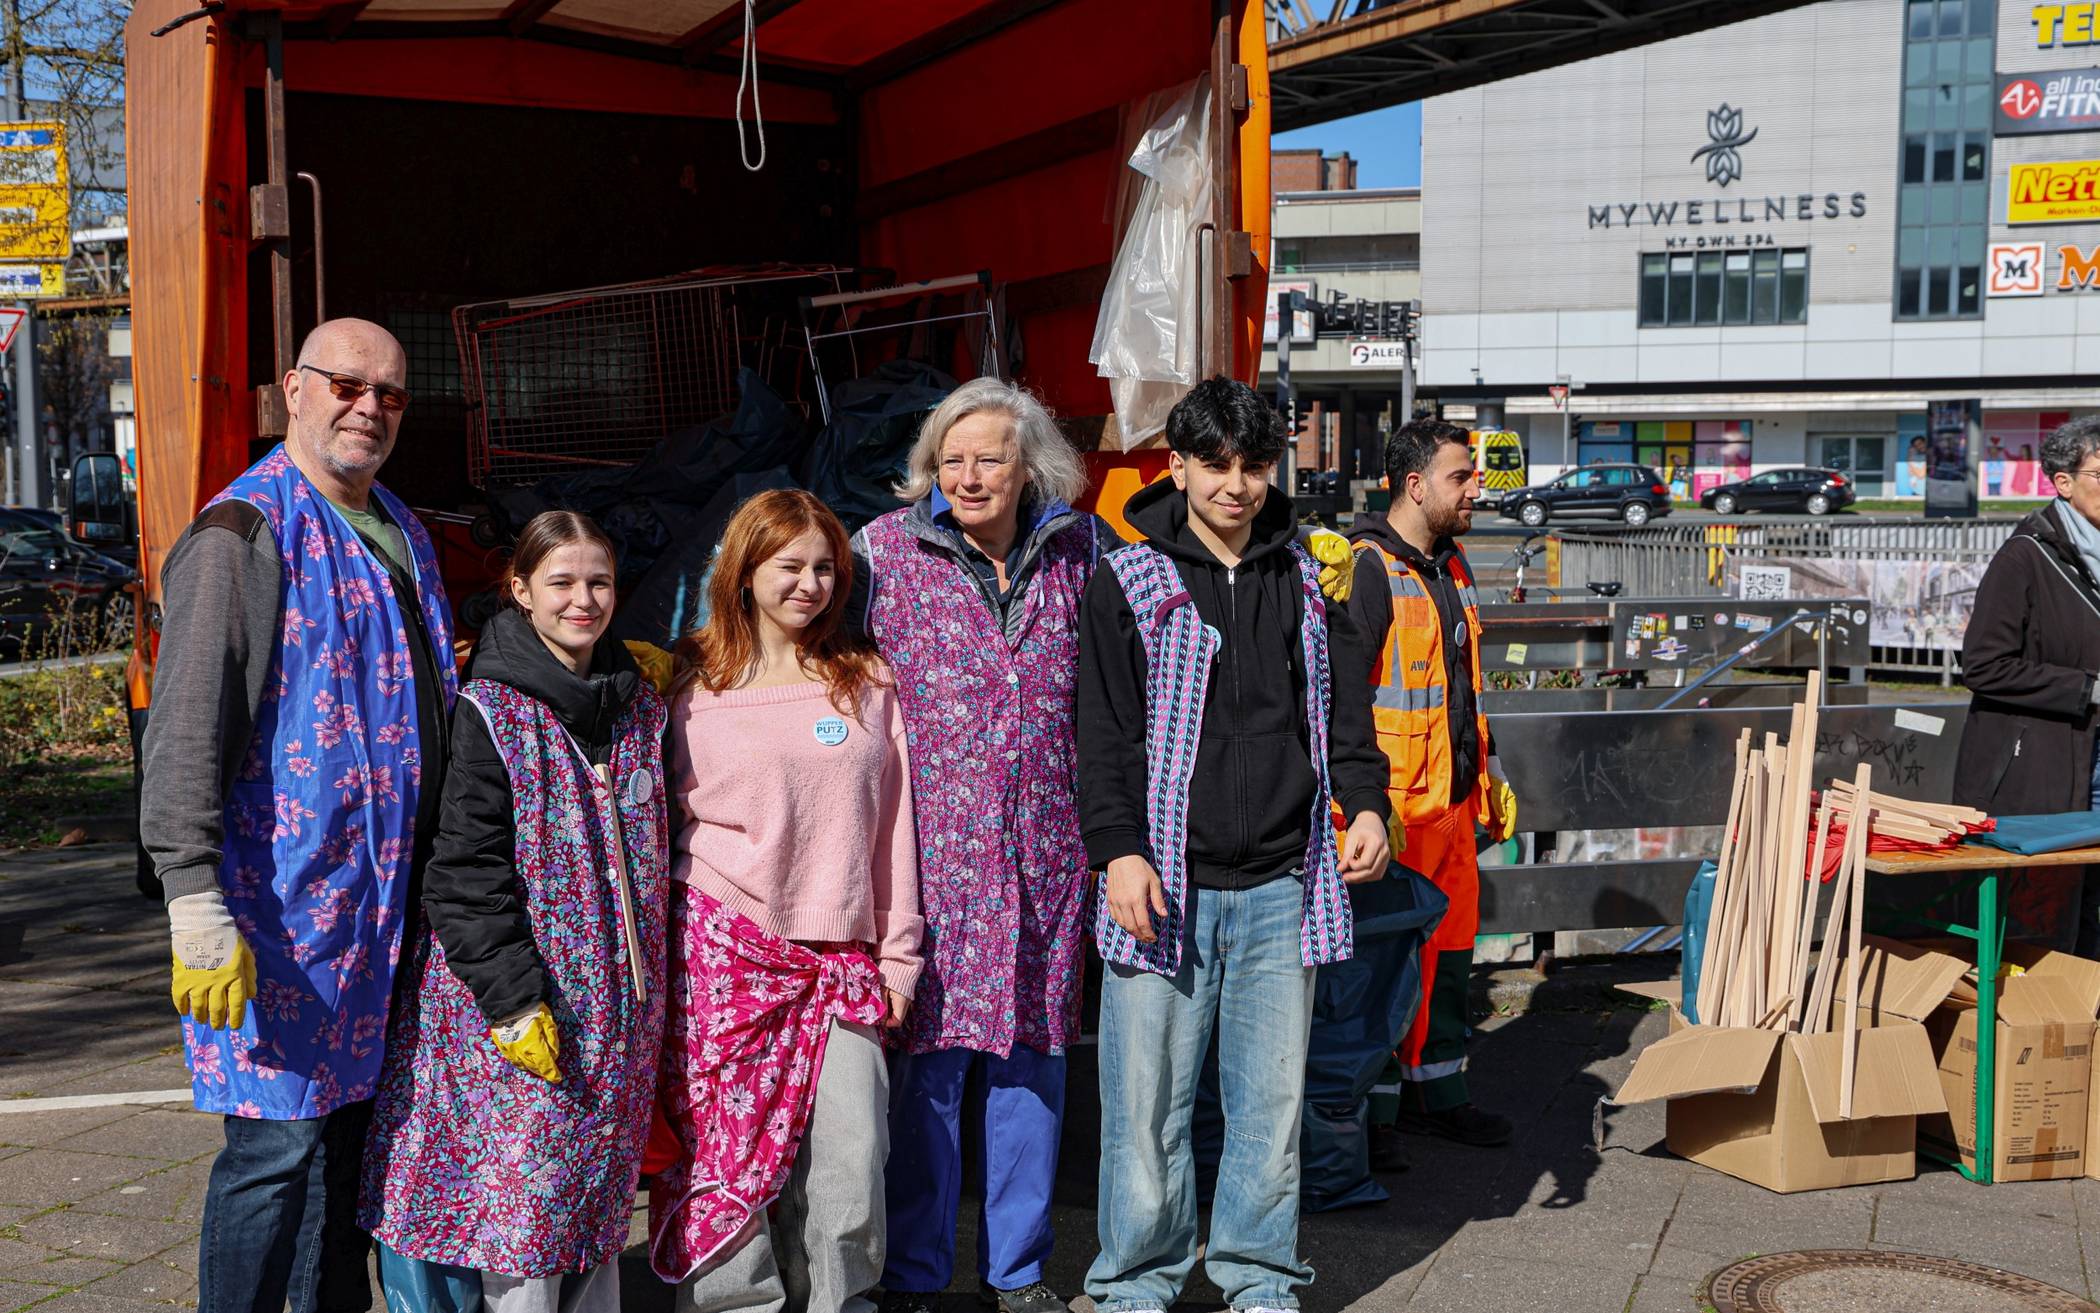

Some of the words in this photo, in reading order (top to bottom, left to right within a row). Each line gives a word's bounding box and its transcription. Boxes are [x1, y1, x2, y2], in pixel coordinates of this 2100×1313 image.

[2031, 2, 2100, 47] TE
[2045, 76, 2071, 94] all
[1588, 192, 1867, 229] MYWELLNESS
[1666, 236, 1687, 248] MY
[1697, 235, 1735, 247] OWN
[1744, 234, 1775, 246] SPA
[816, 726, 844, 734] PUTZ
